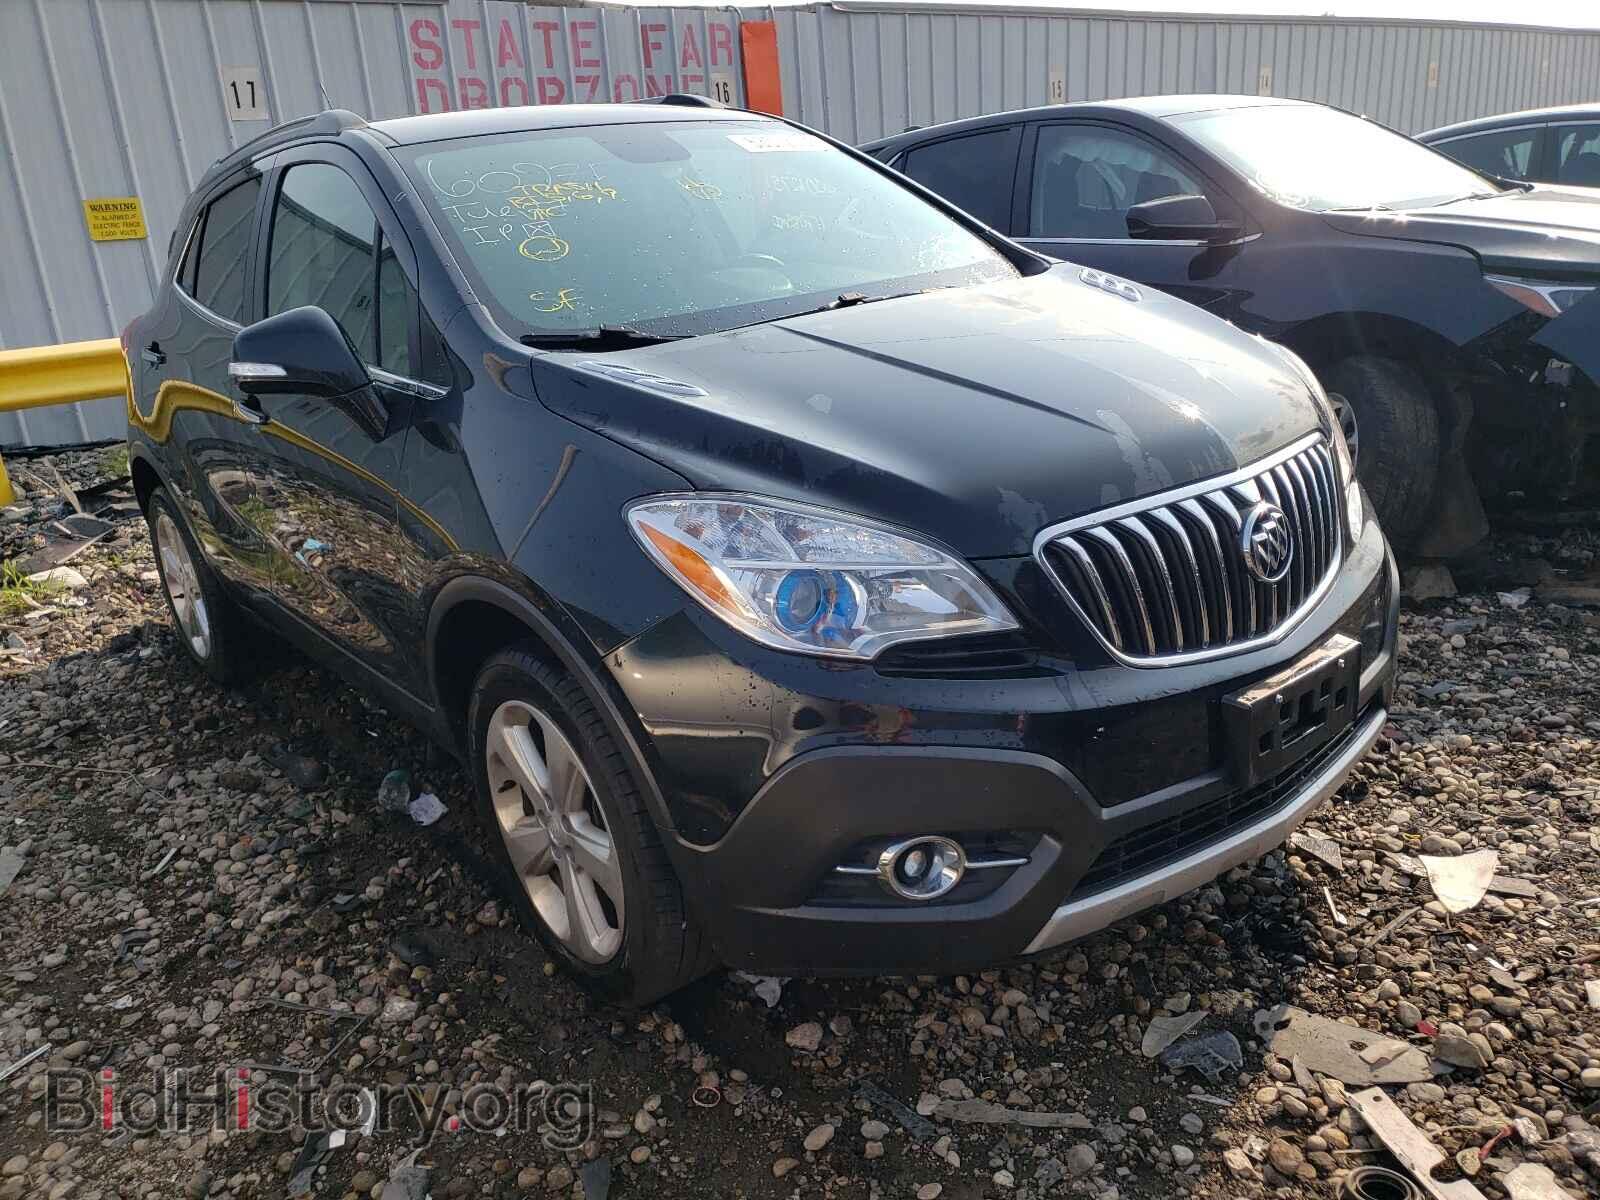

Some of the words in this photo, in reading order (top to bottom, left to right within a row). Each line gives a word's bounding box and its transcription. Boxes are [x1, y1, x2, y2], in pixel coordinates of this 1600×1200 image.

[408, 19, 601, 70] STATE
[230, 80, 256, 109] 17
[714, 81, 731, 104] 16
